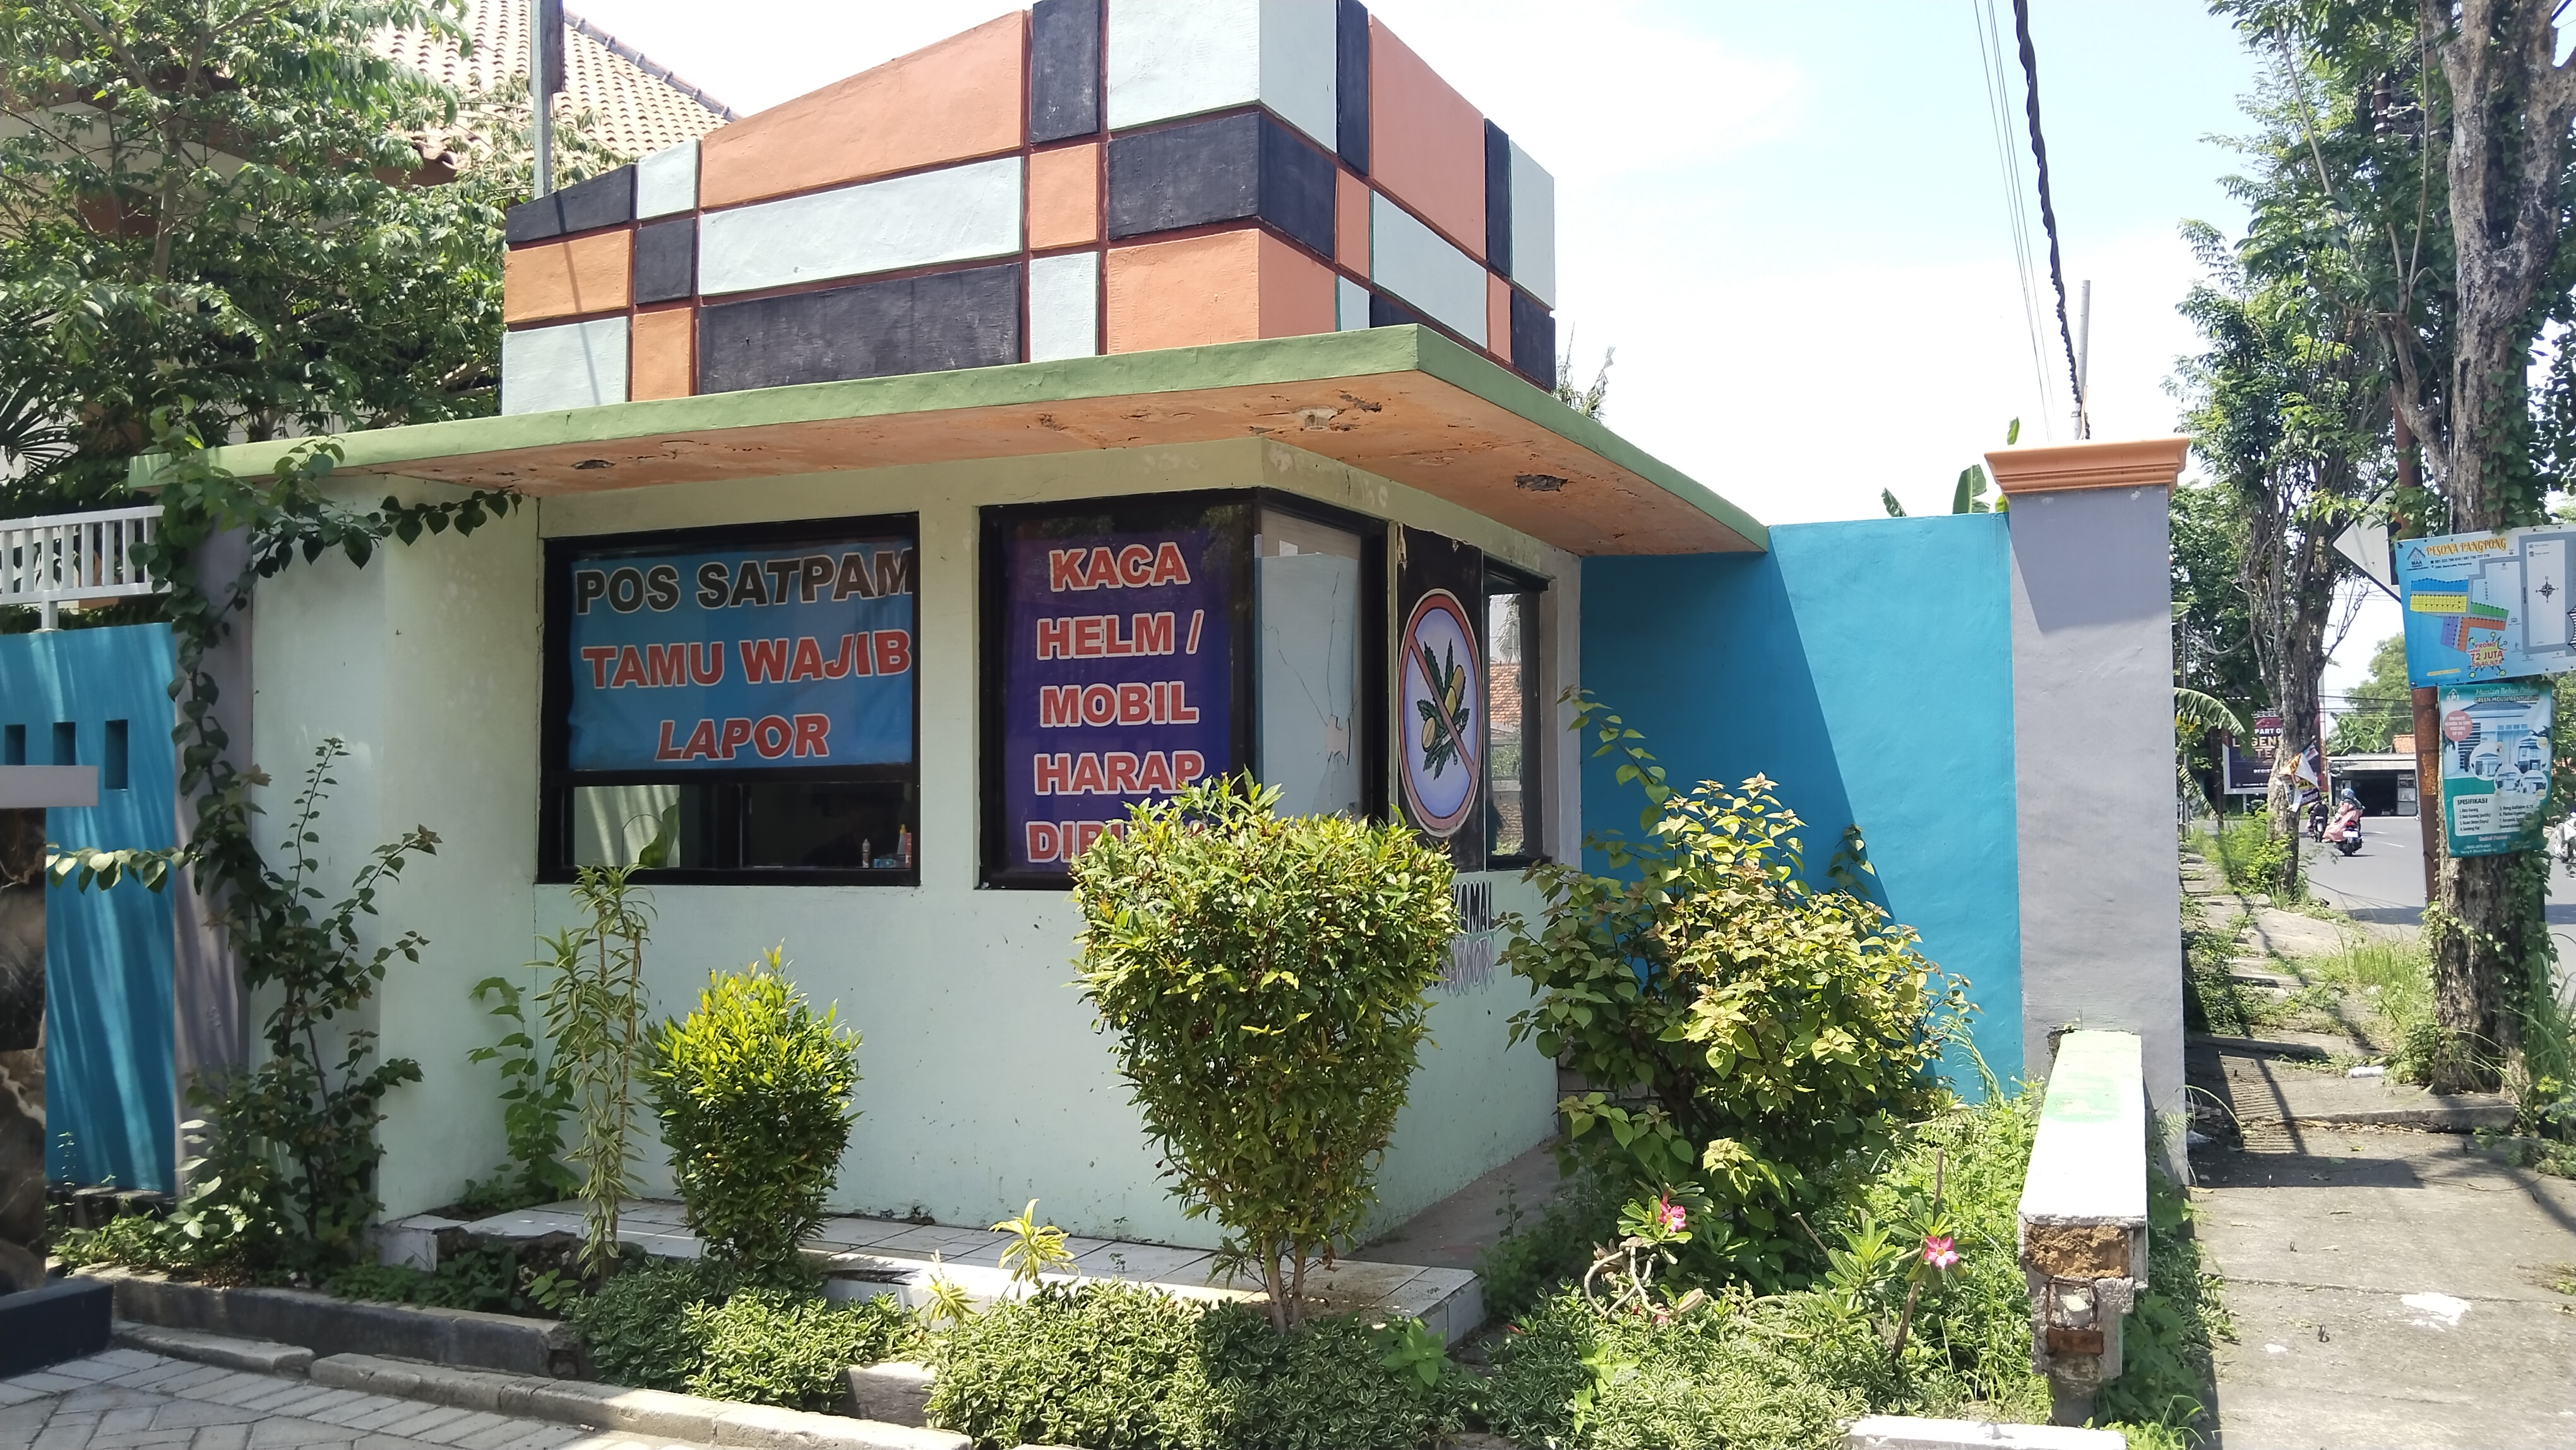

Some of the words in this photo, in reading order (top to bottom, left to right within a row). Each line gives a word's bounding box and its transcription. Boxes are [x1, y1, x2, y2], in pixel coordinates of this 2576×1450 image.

[1049, 541, 1191, 592] KACA
[2425, 544, 2459, 556] PESONA
[2460, 538, 2507, 554] PANGPONG
[575, 564, 680, 615] POS
[696, 547, 913, 609] SATPAM
[581, 641, 724, 688] TAMU
[739, 629, 912, 685] WAJIB
[1037, 611, 1175, 661] HELM
[1186, 609, 1204, 654] /
[2484, 650, 2503, 659] JUTA
[1040, 681, 1200, 728] MOBIL
[655, 714, 830, 762] LAPOR
[2255, 748, 2276, 758] TE
[1034, 750, 1205, 796] HARAP
